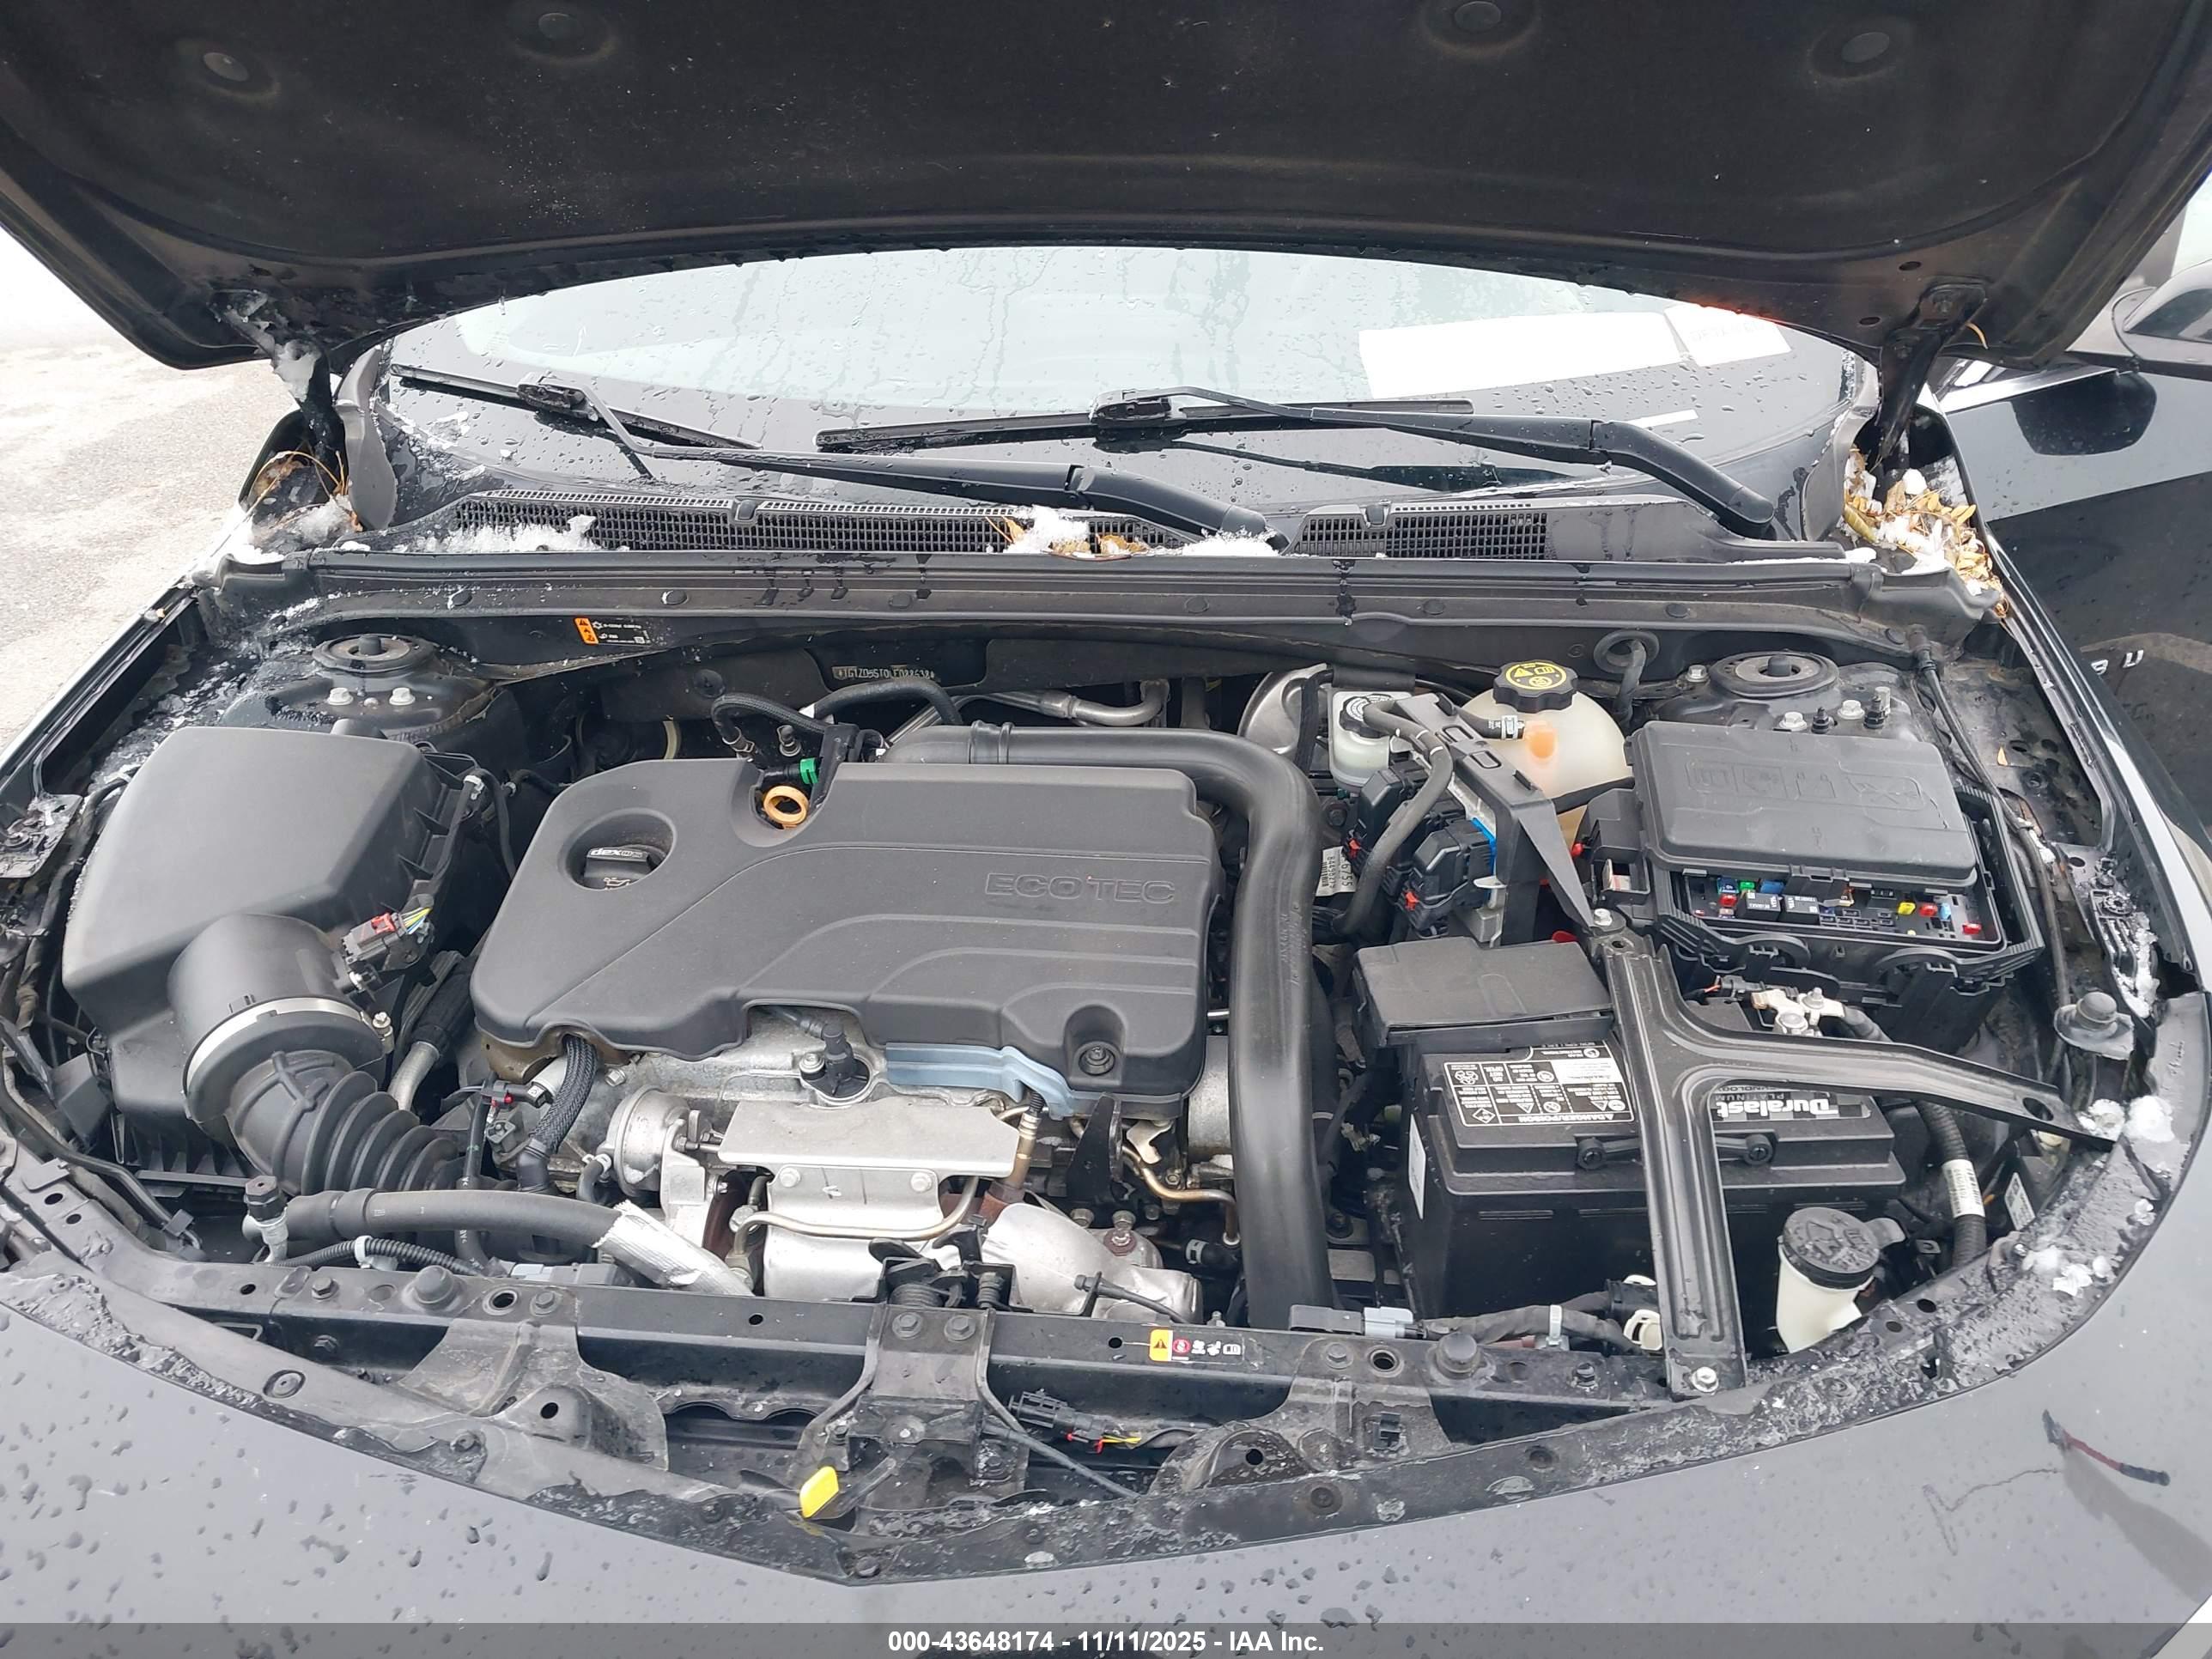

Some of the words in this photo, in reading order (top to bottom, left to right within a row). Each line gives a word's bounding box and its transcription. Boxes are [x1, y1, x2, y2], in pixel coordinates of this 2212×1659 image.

[985, 872, 1175, 904] ECOTEC
[1715, 1092, 1784, 1101] PLATINUM
[1717, 1098, 1838, 1118] Duralast
